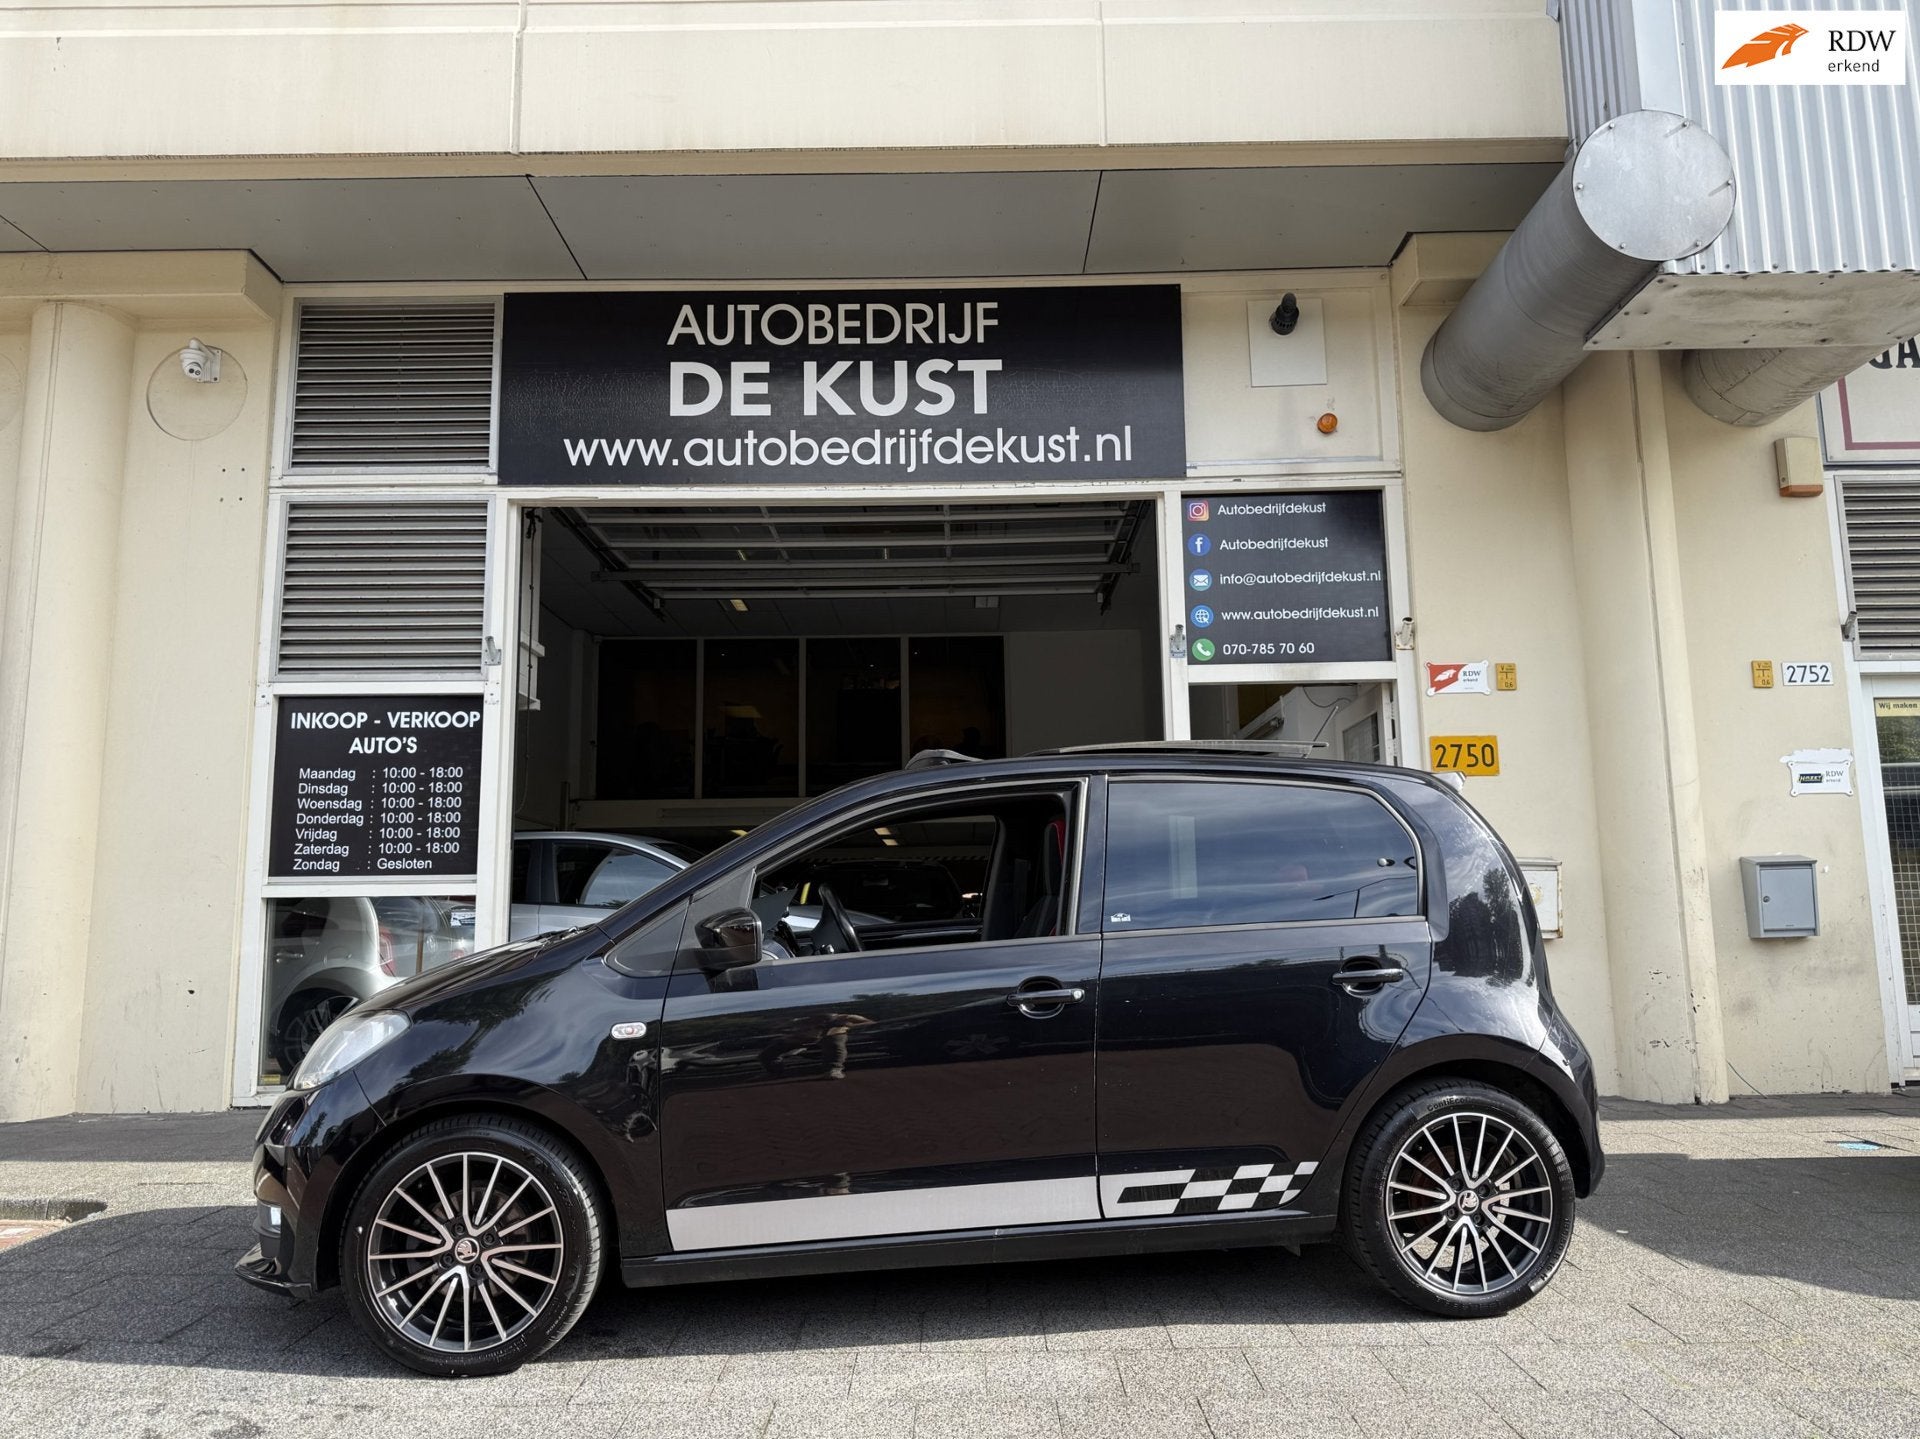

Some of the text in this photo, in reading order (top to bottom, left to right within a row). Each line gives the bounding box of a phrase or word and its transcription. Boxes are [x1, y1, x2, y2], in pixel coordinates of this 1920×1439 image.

[666, 301, 999, 346] AUTOBEDRIJF
[669, 358, 1003, 417] DE KUST
[563, 425, 1132, 473] www.autobedrijfdekust.nl
[1217, 502, 1327, 517] Autobedrijfdekust
[1219, 537, 1329, 552] Autobedrijfdekust
[1219, 570, 1382, 586] info@autobedrijfdekust.nl
[1221, 606, 1380, 621] www.autobedrijfdekust.nl
[1222, 642, 1315, 655] 070-785 70 60
[1786, 664, 1831, 683] 2752
[1878, 702, 1891, 710] Wij
[291, 711, 368, 730] INKOOP
[387, 710, 481, 729] VERKOOP
[348, 736, 418, 754] AUTO'S
[1434, 743, 1495, 769] 2750
[299, 767, 356, 782] Maandag
[383, 767, 417, 779] 10:00
[429, 766, 464, 779] 18:00
[298, 782, 349, 797] Dinsdag
[382, 781, 416, 794] 10:00
[428, 781, 463, 793] 18:00
[297, 797, 363, 812] Woensdag
[381, 796, 415, 809] 10:00
[427, 796, 462, 809] 18:00
[296, 812, 364, 827] Donderdag
[380, 812, 415, 824] 10:00
[426, 811, 461, 824] 18:00
[295, 828, 338, 843] Vrijdag
[379, 827, 414, 839] 10:00
[426, 826, 461, 839] 18:00
[293, 843, 350, 858] Zaterdag
[378, 842, 413, 854] 10:00
[425, 841, 460, 854] 18:00
[292, 858, 340, 873] Zondag
[377, 857, 433, 870] Gesloten
